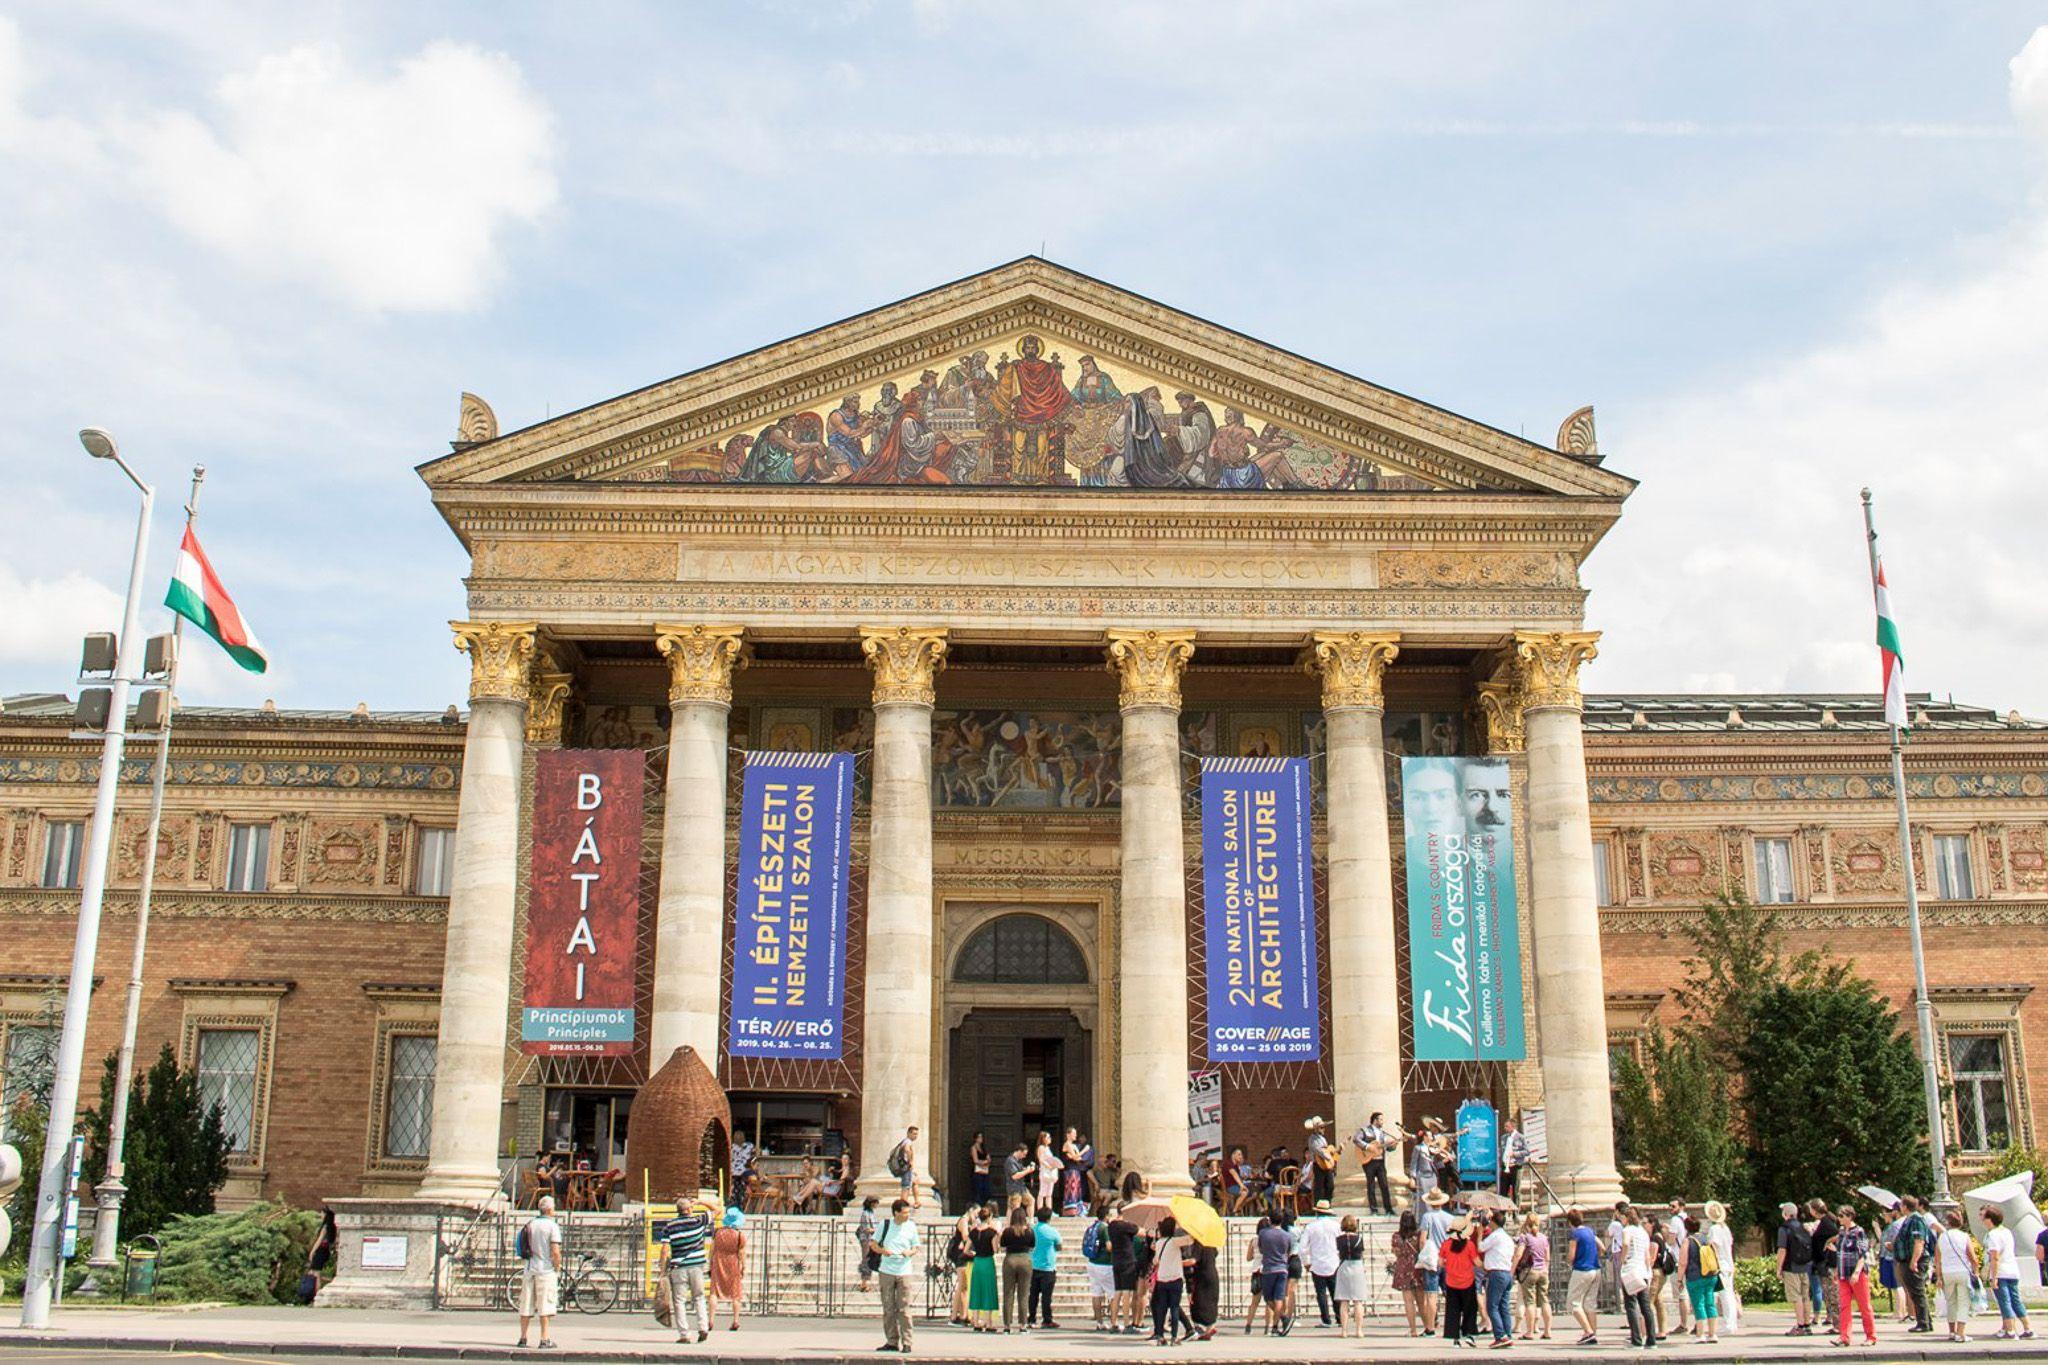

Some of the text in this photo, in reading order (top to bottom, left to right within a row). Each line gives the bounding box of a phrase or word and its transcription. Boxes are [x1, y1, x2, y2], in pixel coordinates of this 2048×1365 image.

[719, 554, 735, 575] A
[751, 554, 865, 577] MAGYAR
[1223, 789, 1238, 851] SALON
[749, 783, 789, 966] ÉPÍTÉSZETI
[1428, 831, 1441, 888] COUNTRY
[786, 784, 816, 1007] NEMZETI SZALON
[1224, 856, 1242, 954] NATIONAL
[1245, 888, 1255, 907] OF
[1255, 789, 1283, 1009] ARCHITECTURE
[1474, 901, 1488, 947] mexikói
[1423, 834, 1473, 1046] Frida országa
[1477, 951, 1490, 984] Kahlo
[530, 1009, 626, 1027] Principiumok
[548, 1026, 607, 1041] Principles
[1480, 988, 1494, 1047] Guillermo
[1231, 1043, 1245, 1052] 04
[1258, 1043, 1271, 1052] 25
[1289, 1043, 1312, 1052] 2019
